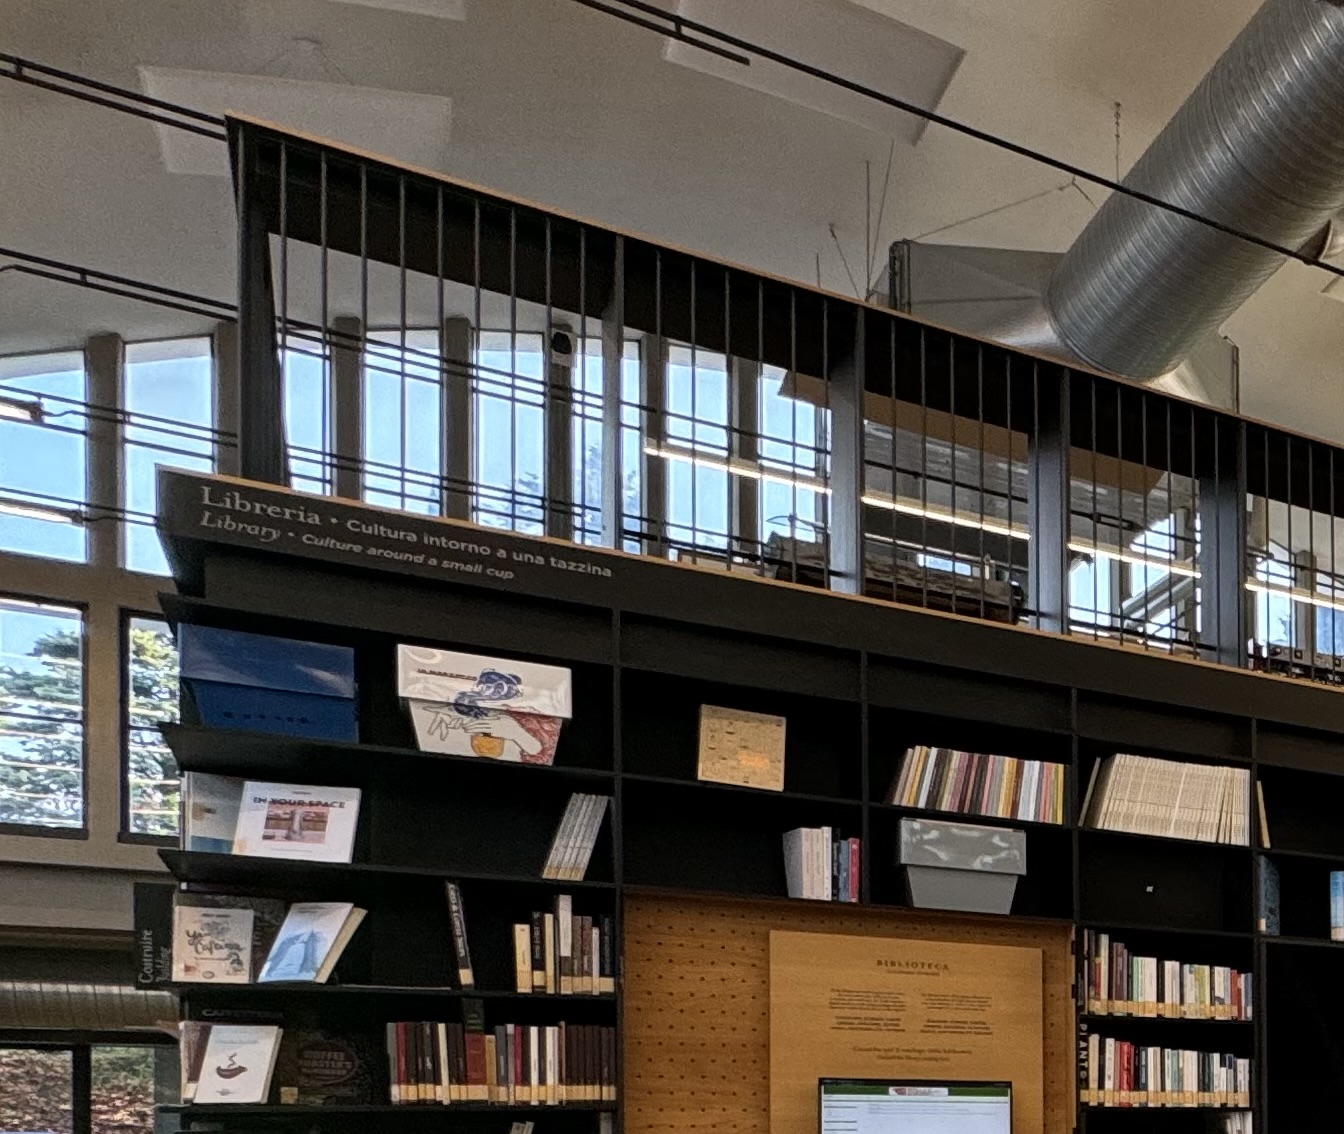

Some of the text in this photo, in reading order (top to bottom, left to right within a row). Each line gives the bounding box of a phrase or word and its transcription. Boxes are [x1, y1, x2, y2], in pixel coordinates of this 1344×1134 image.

[199, 510, 515, 581] Library Culture around a small cup
[200, 486, 613, 578] Libreria Cultura intorno a una tazzina
[270, 798, 306, 807] YOUR
[308, 800, 346, 809] SPACE
[876, 959, 949, 971] BIBLIOTECA
